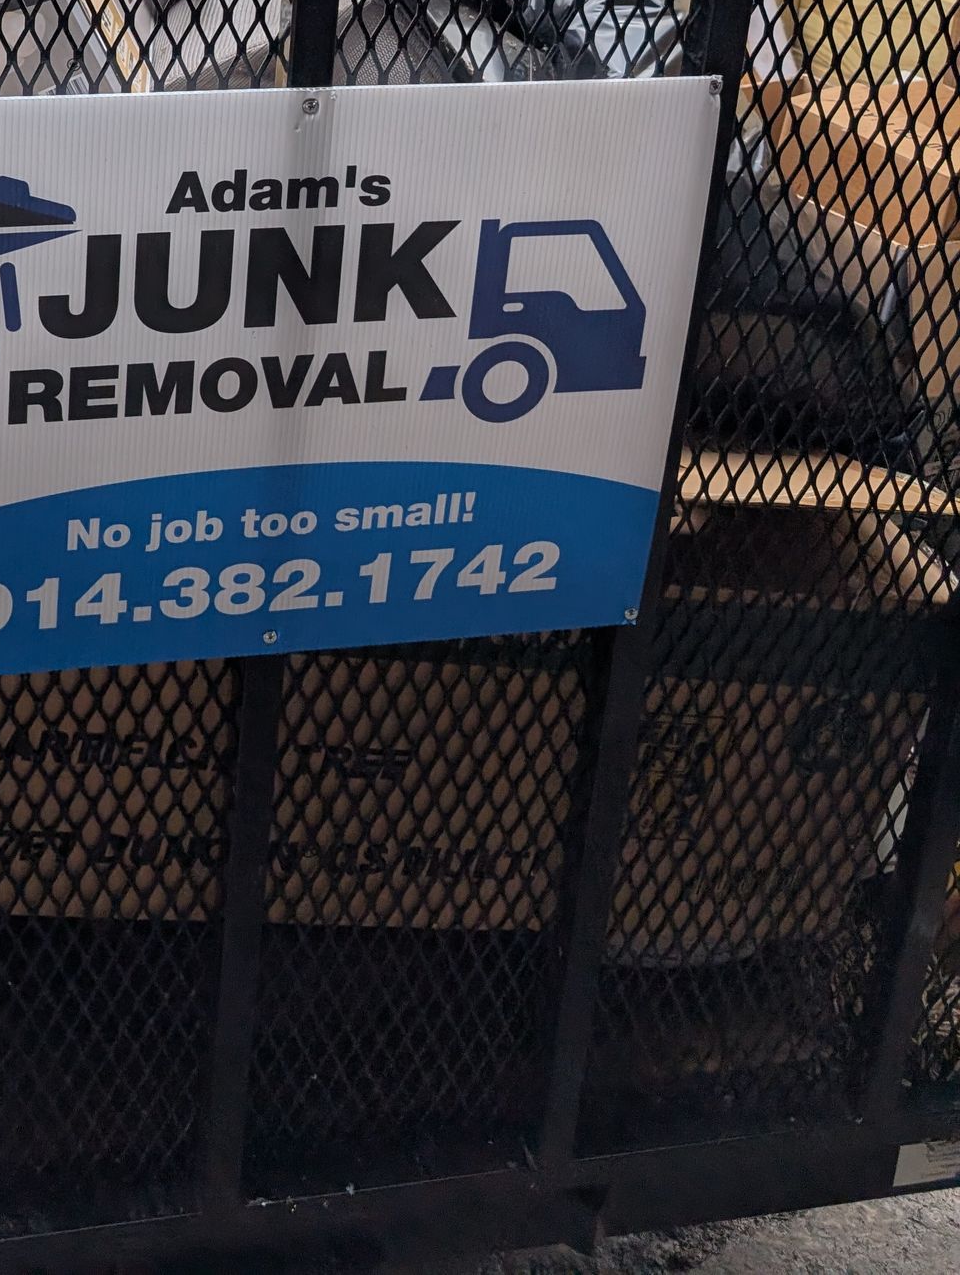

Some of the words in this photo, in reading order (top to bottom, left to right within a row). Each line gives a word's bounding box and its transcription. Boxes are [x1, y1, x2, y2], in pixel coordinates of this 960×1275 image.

[166, 166, 391, 215] Adam's
[38, 219, 462, 339] JUNK
[7, 351, 408, 425] REMOVAL
[66, 518, 131, 551] No
[145, 512, 223, 553] job
[240, 506, 317, 538] too
[334, 491, 475, 532] small!
